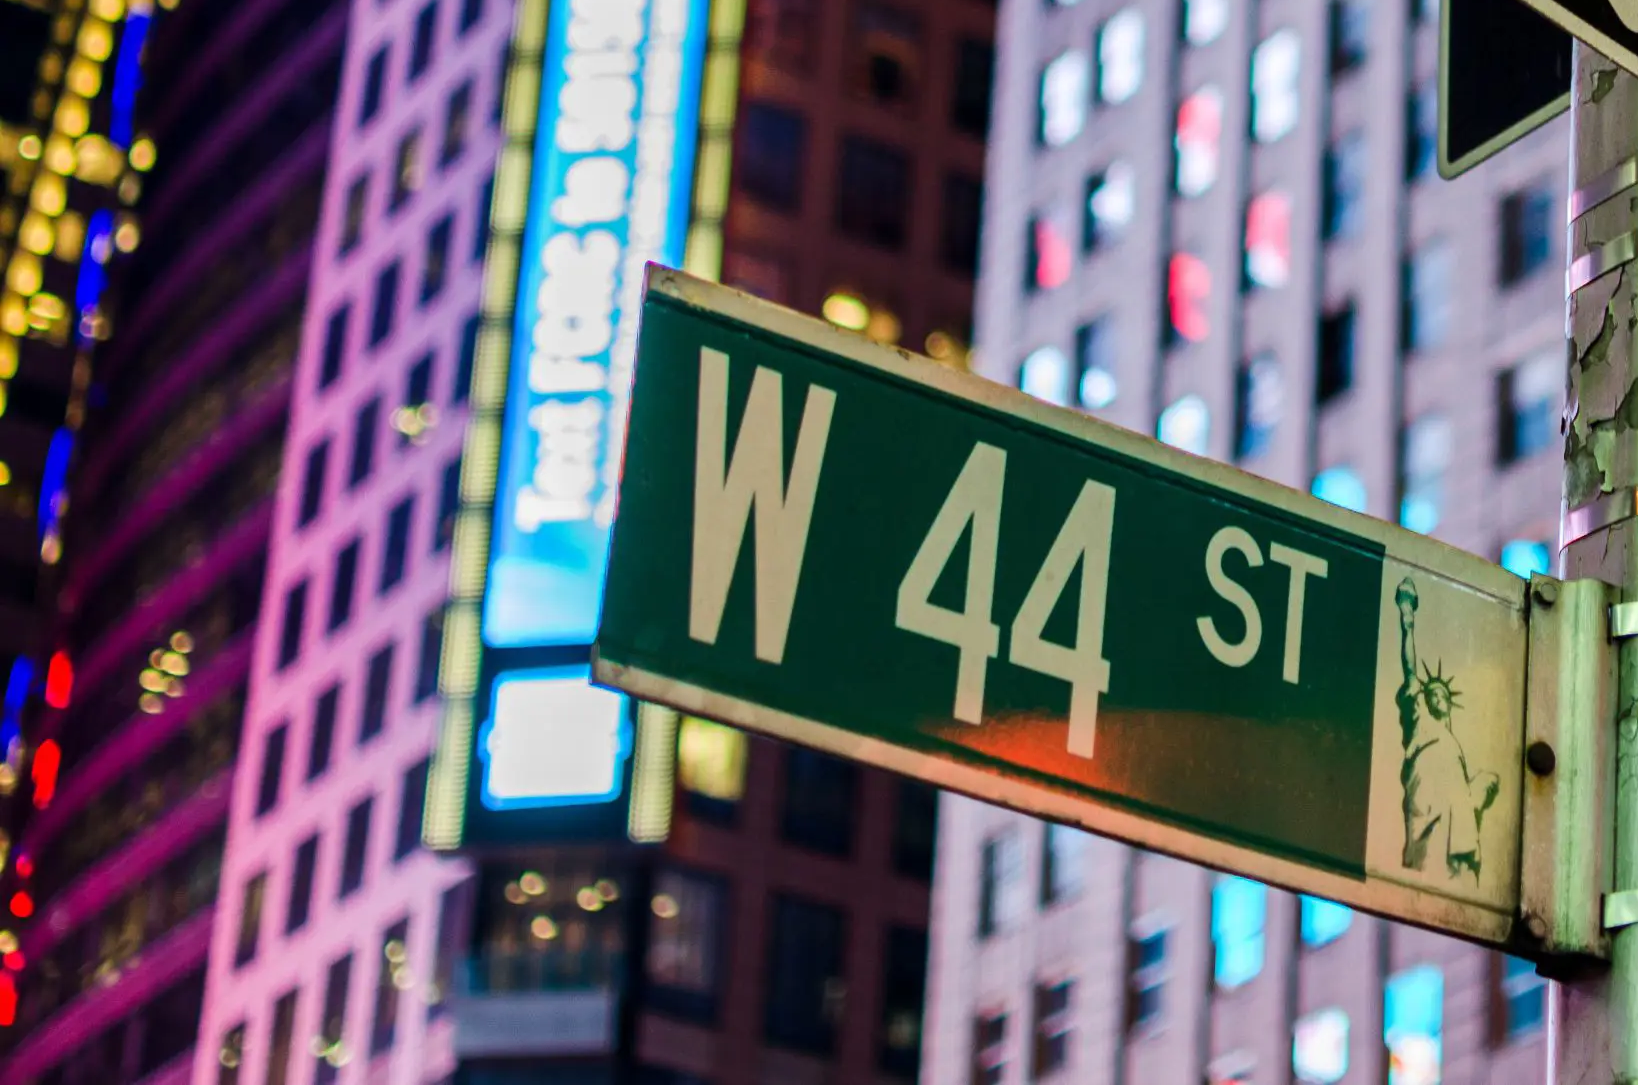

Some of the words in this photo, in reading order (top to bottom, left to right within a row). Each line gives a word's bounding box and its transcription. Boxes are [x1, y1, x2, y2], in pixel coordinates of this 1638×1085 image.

[687, 346, 838, 665] W
[894, 441, 1117, 760] 44
[1196, 525, 1328, 685] ST
